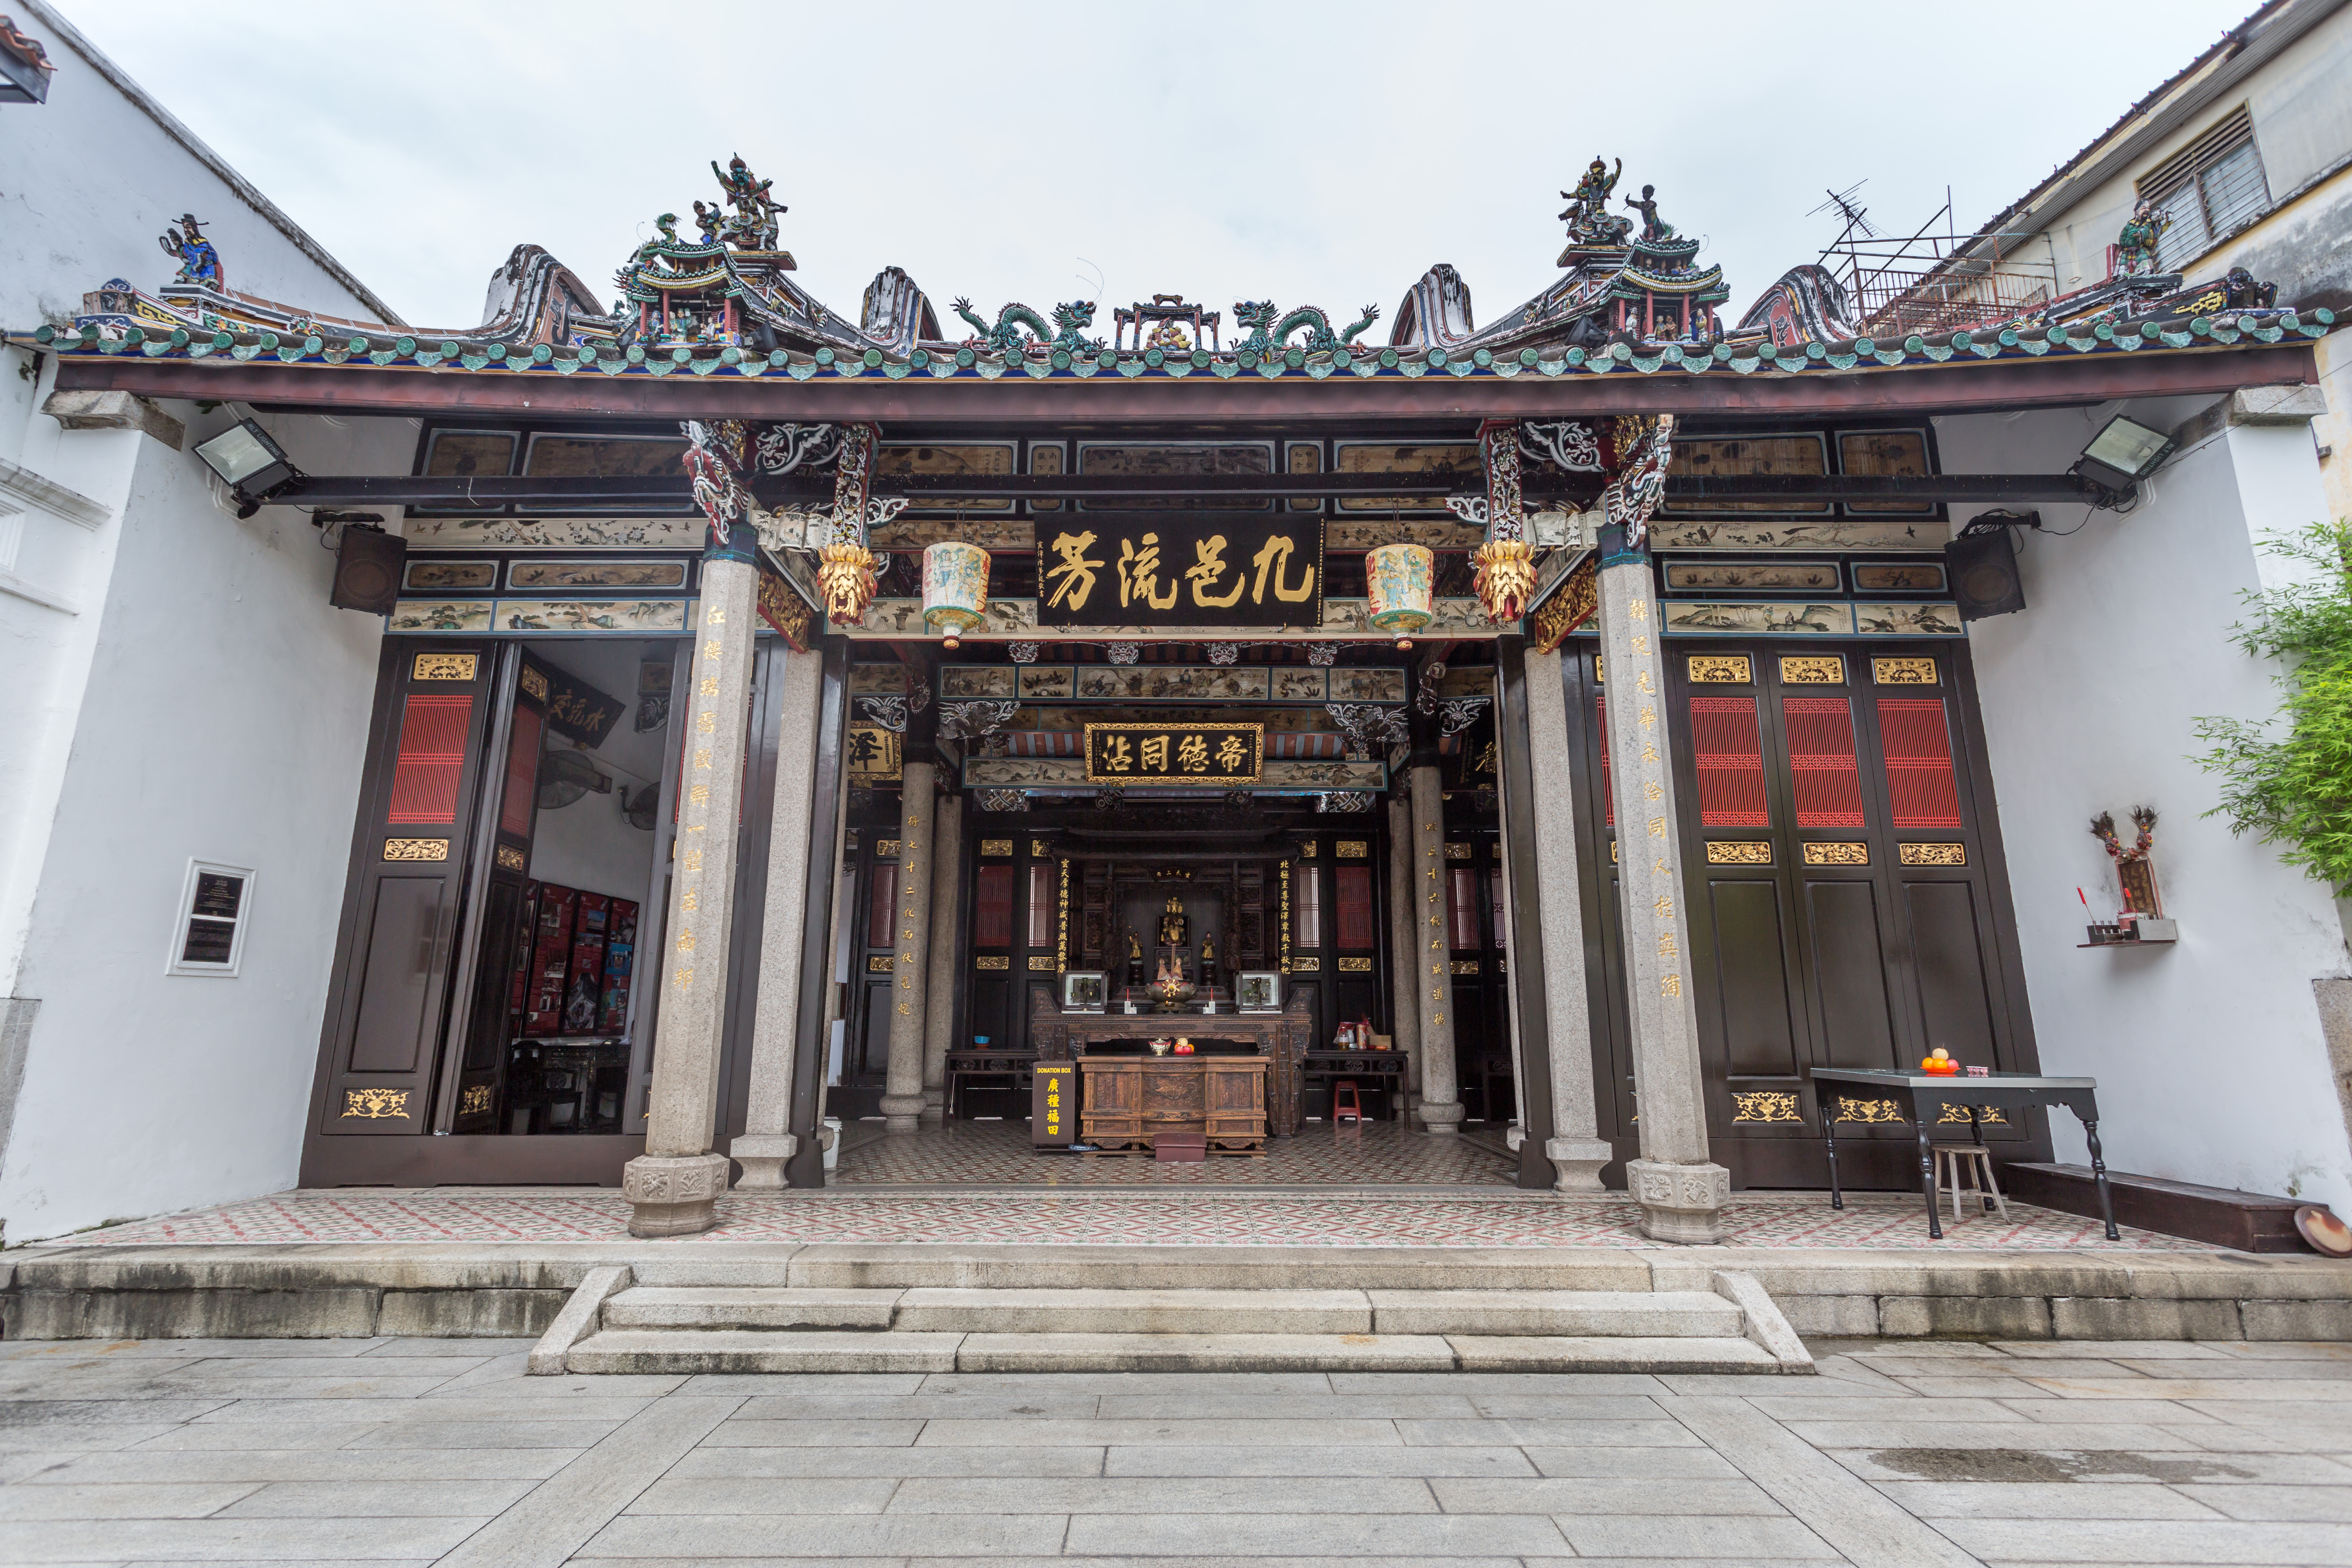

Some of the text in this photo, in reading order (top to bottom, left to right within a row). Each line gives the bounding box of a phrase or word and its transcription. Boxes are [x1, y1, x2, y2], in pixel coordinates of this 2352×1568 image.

[247, 423, 281, 456] RLT LIGHTING
[2139, 443, 2174, 476] RLT LIGHTING
[1102, 733, 1249, 773] 帝德同沾
[1047, 1078, 1060, 1136] 廣種福田
